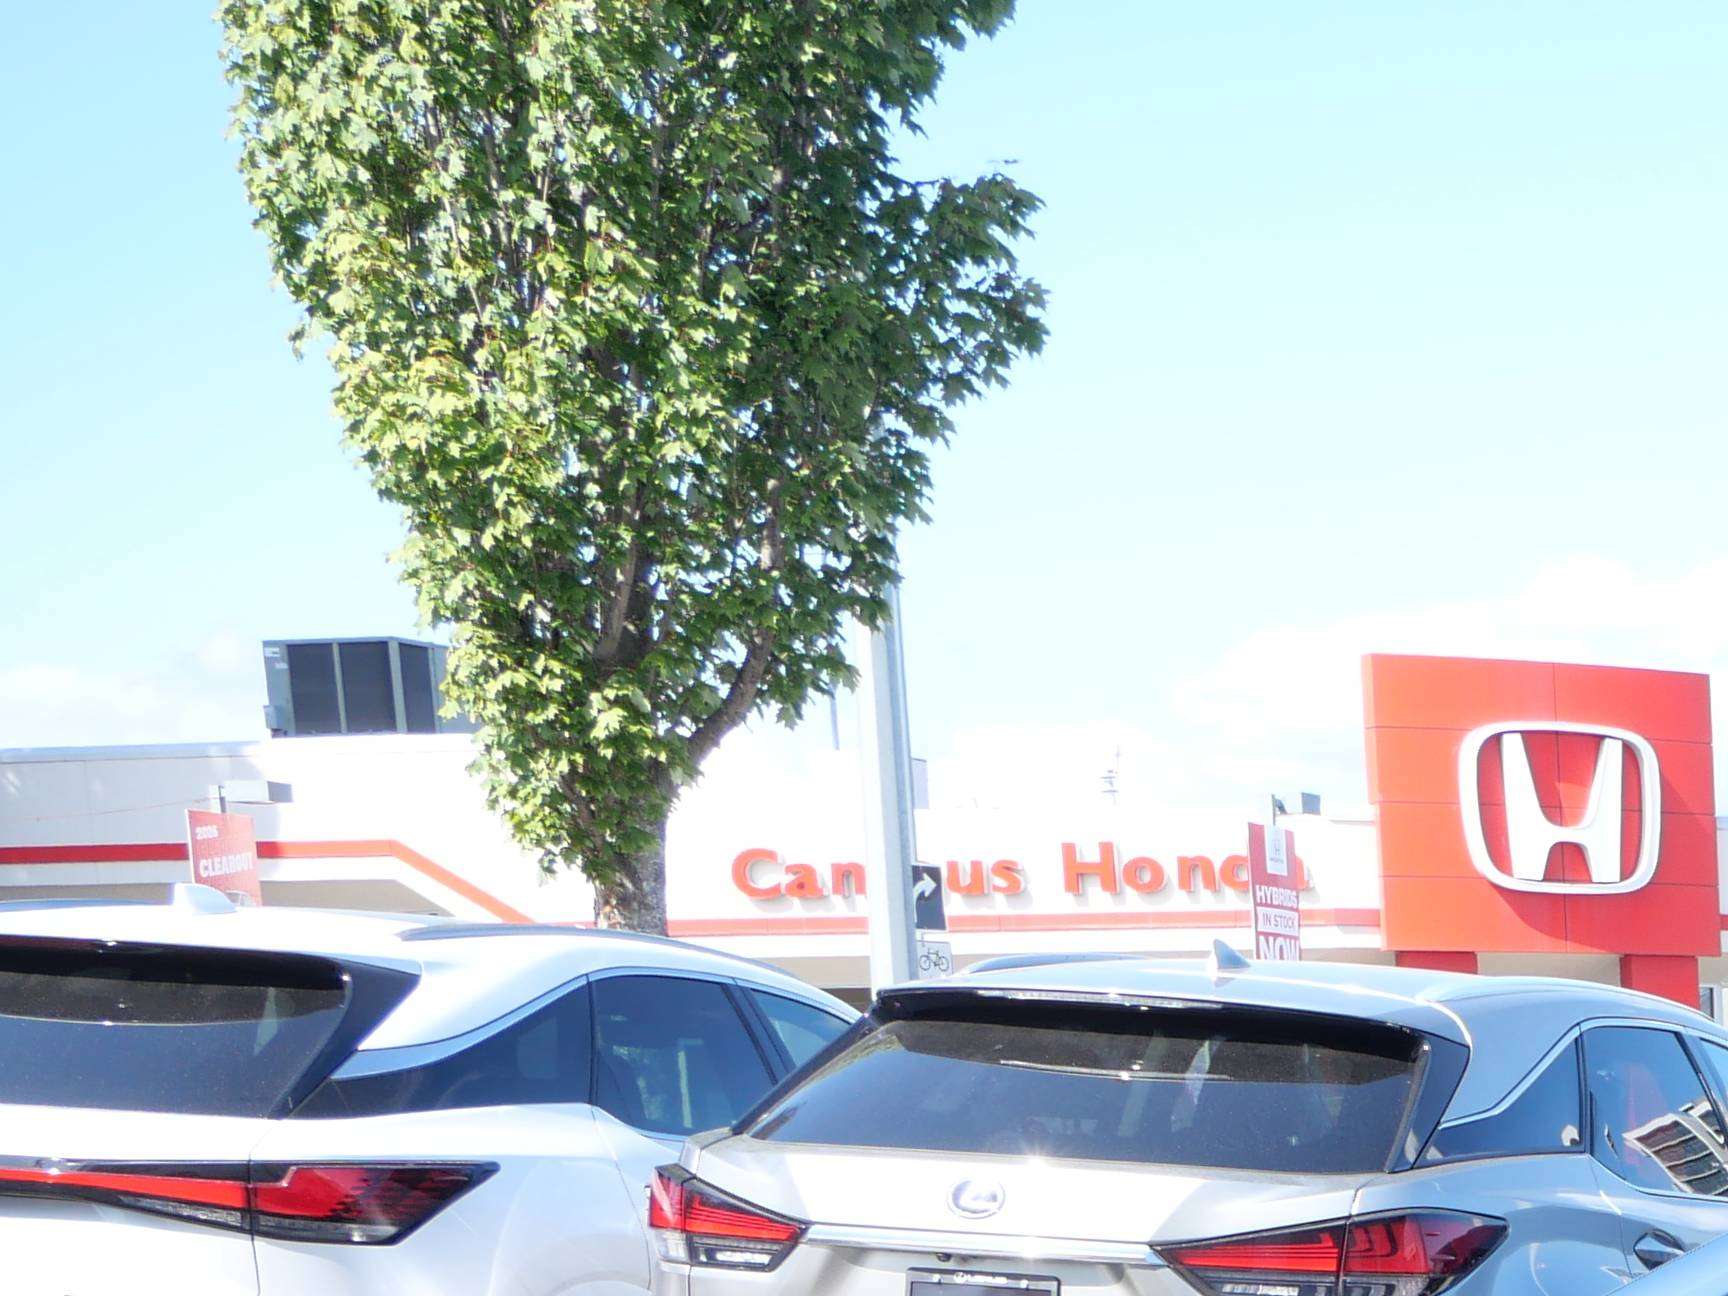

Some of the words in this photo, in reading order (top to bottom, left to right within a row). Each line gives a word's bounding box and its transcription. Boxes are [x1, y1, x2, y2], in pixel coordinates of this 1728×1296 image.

[200, 852, 254, 878] CLEAROUT
[1255, 885, 1298, 909] HYBRIDS
[1262, 911, 1272, 927] IN
[1273, 913, 1296, 930] STOCK
[1259, 935, 1300, 960] NOW
